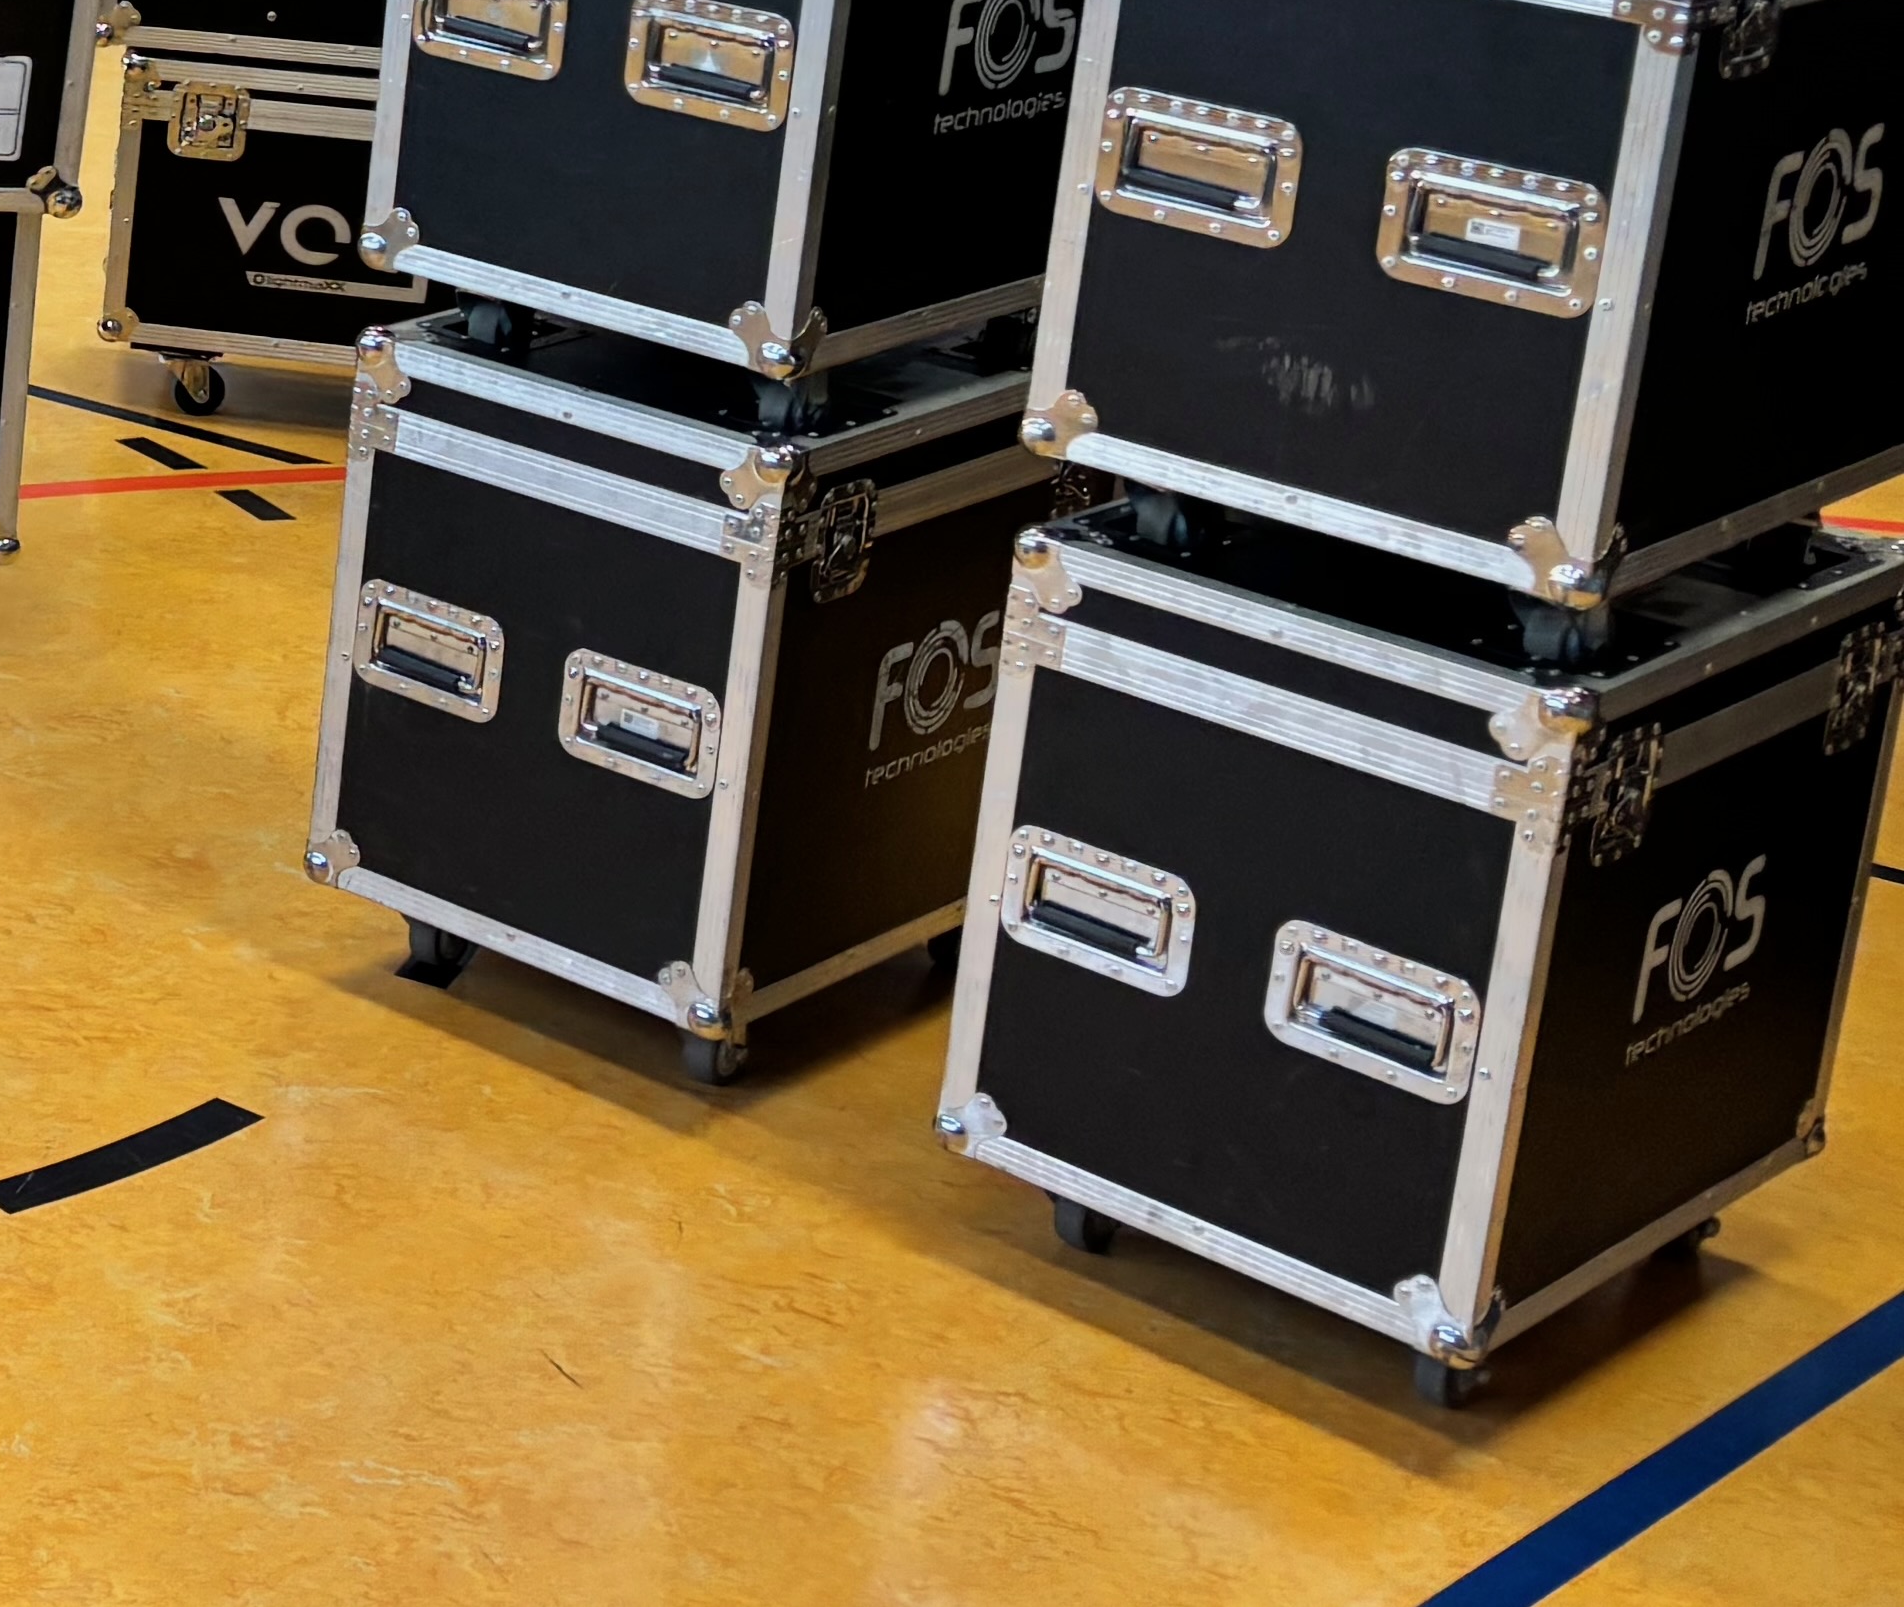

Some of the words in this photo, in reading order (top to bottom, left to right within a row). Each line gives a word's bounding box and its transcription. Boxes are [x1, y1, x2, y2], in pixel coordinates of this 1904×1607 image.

[933, 91, 1066, 135] technologies
[1752, 121, 1885, 282] FOS
[1745, 261, 1868, 325] technologies
[868, 610, 1000, 751] FOS
[1632, 853, 1767, 1025] FOS
[1625, 981, 1751, 1068] technologies
